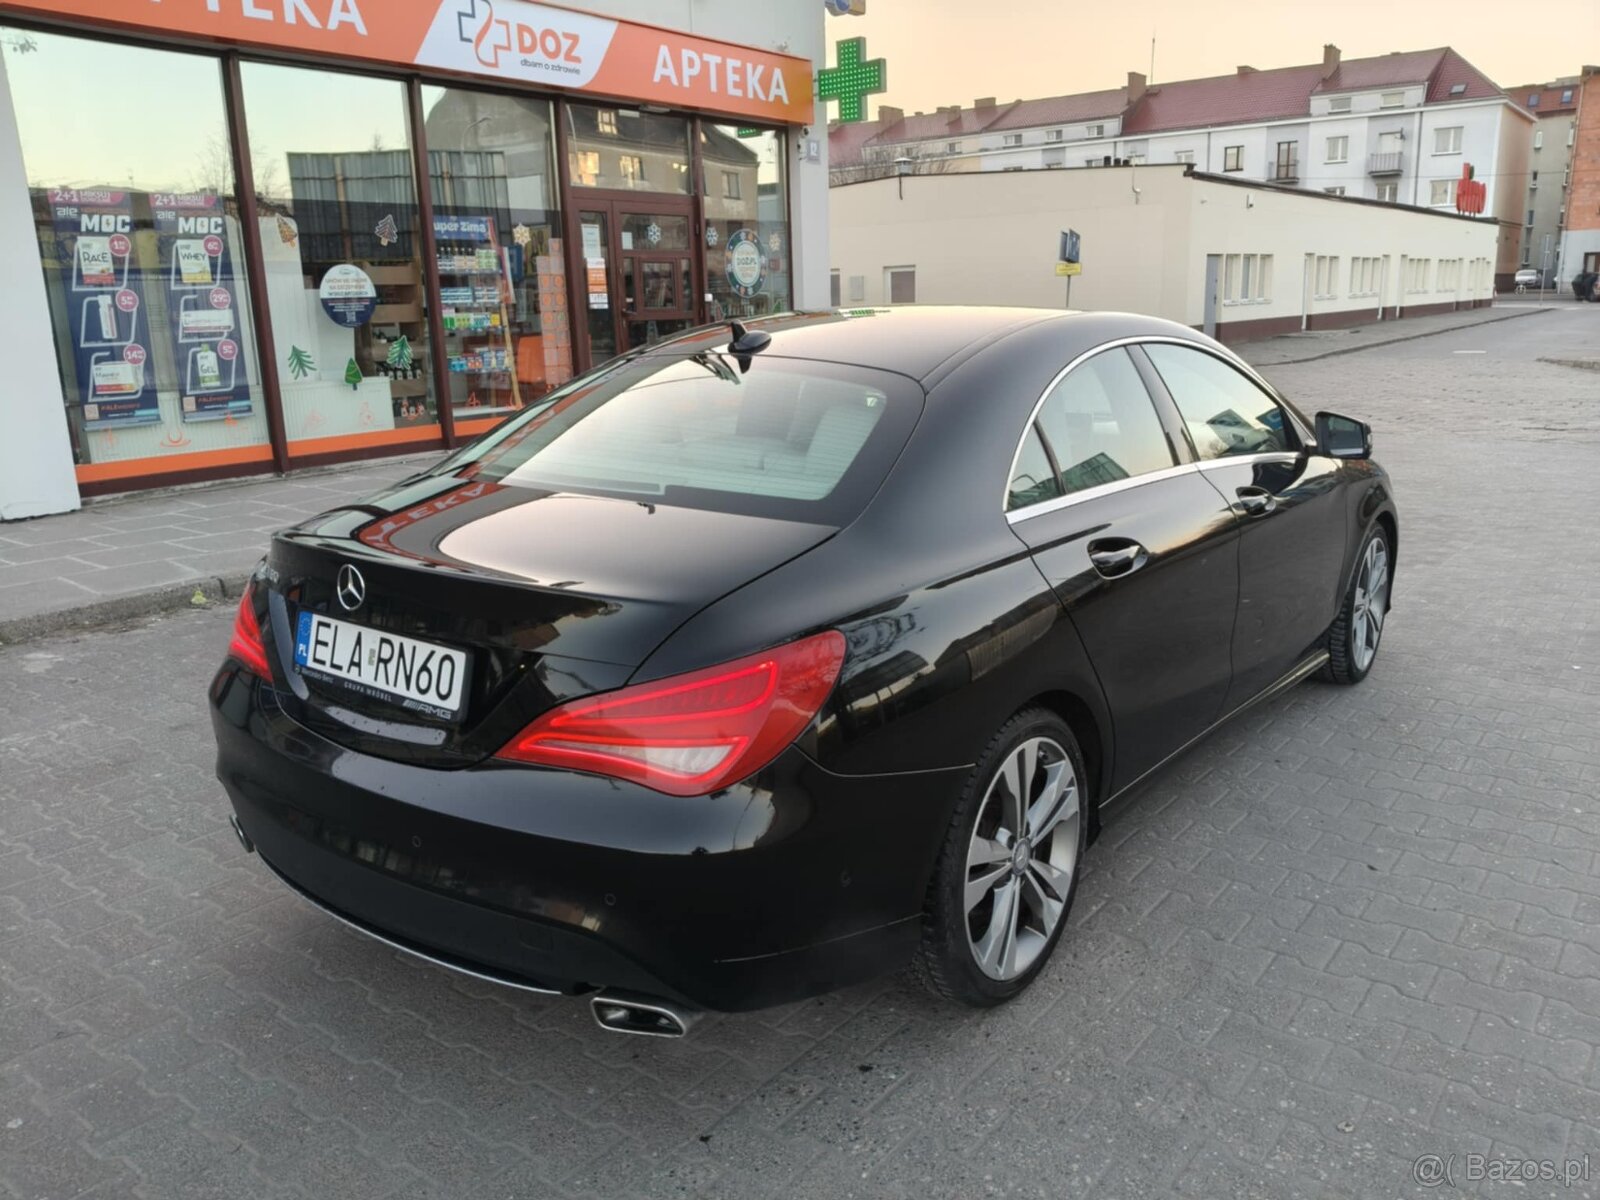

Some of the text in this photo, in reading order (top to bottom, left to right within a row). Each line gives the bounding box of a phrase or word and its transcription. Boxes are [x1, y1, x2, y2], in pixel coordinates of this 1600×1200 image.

[517, 23, 582, 64] DOZ
[520, 58, 581, 76] dbam o zdrowie
[652, 44, 789, 105] APTEKA
[54, 189, 79, 202] 2+1
[154, 193, 177, 206] 2+1
[81, 214, 130, 233] MOC
[178, 217, 223, 234] MOC
[433, 221, 486, 234] uper Zima
[82, 251, 109, 263] RACE
[180, 252, 206, 261] WHEY
[298, 643, 308, 658] PL
[312, 620, 456, 701] ELA RN60
[343, 681, 393, 703] GRUPA WRÓBEL
[416, 703, 452, 720] AMG
